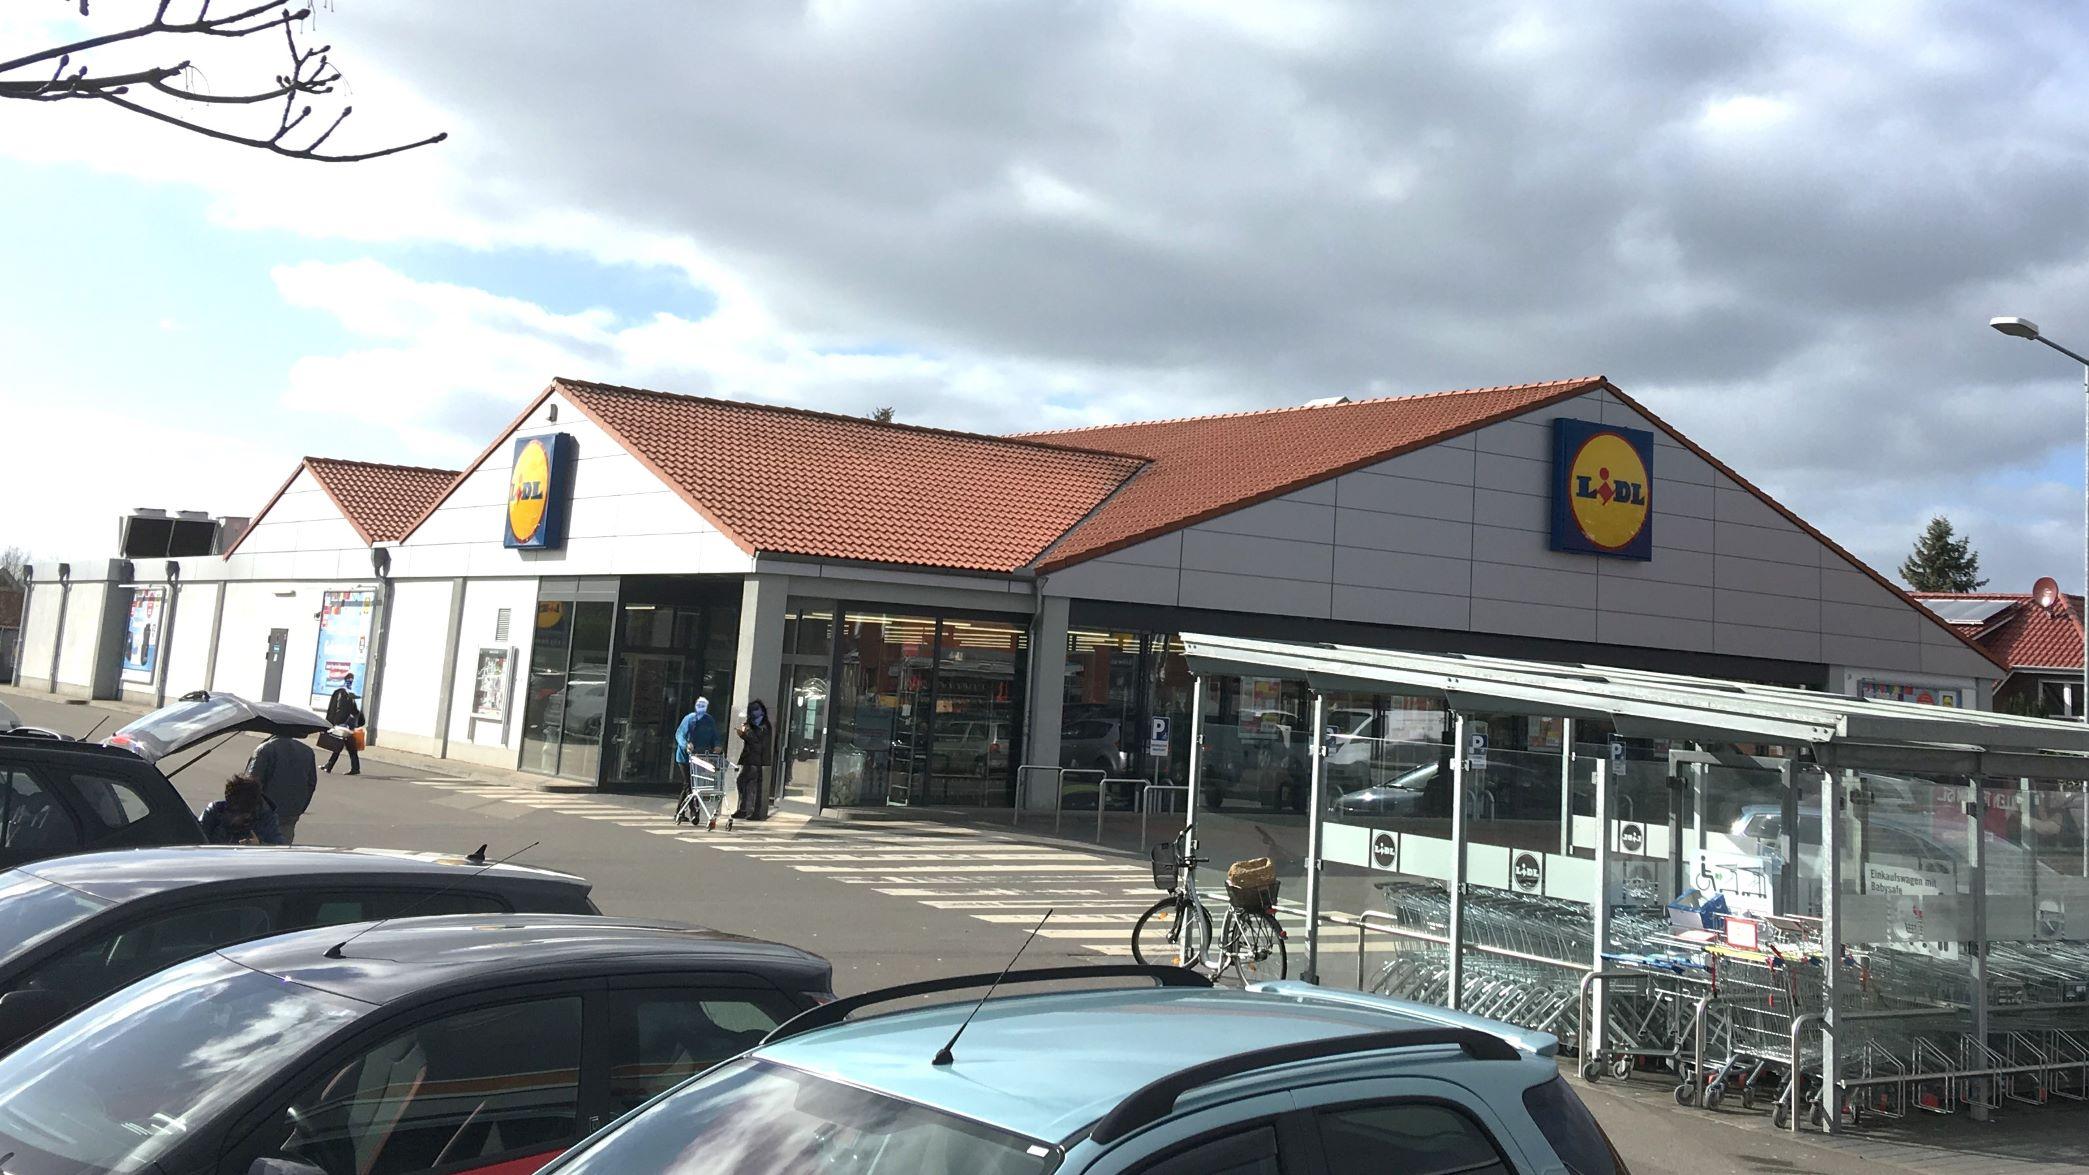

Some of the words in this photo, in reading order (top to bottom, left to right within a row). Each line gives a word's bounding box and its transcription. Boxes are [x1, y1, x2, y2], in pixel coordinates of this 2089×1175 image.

[1152, 719, 1166, 740] P
[1468, 735, 1484, 754] P
[1611, 743, 1623, 761] P
[1870, 868, 1923, 887] Einkaufswagen
[1924, 878, 1937, 889] mit
[1871, 881, 1903, 896] Babysafe
